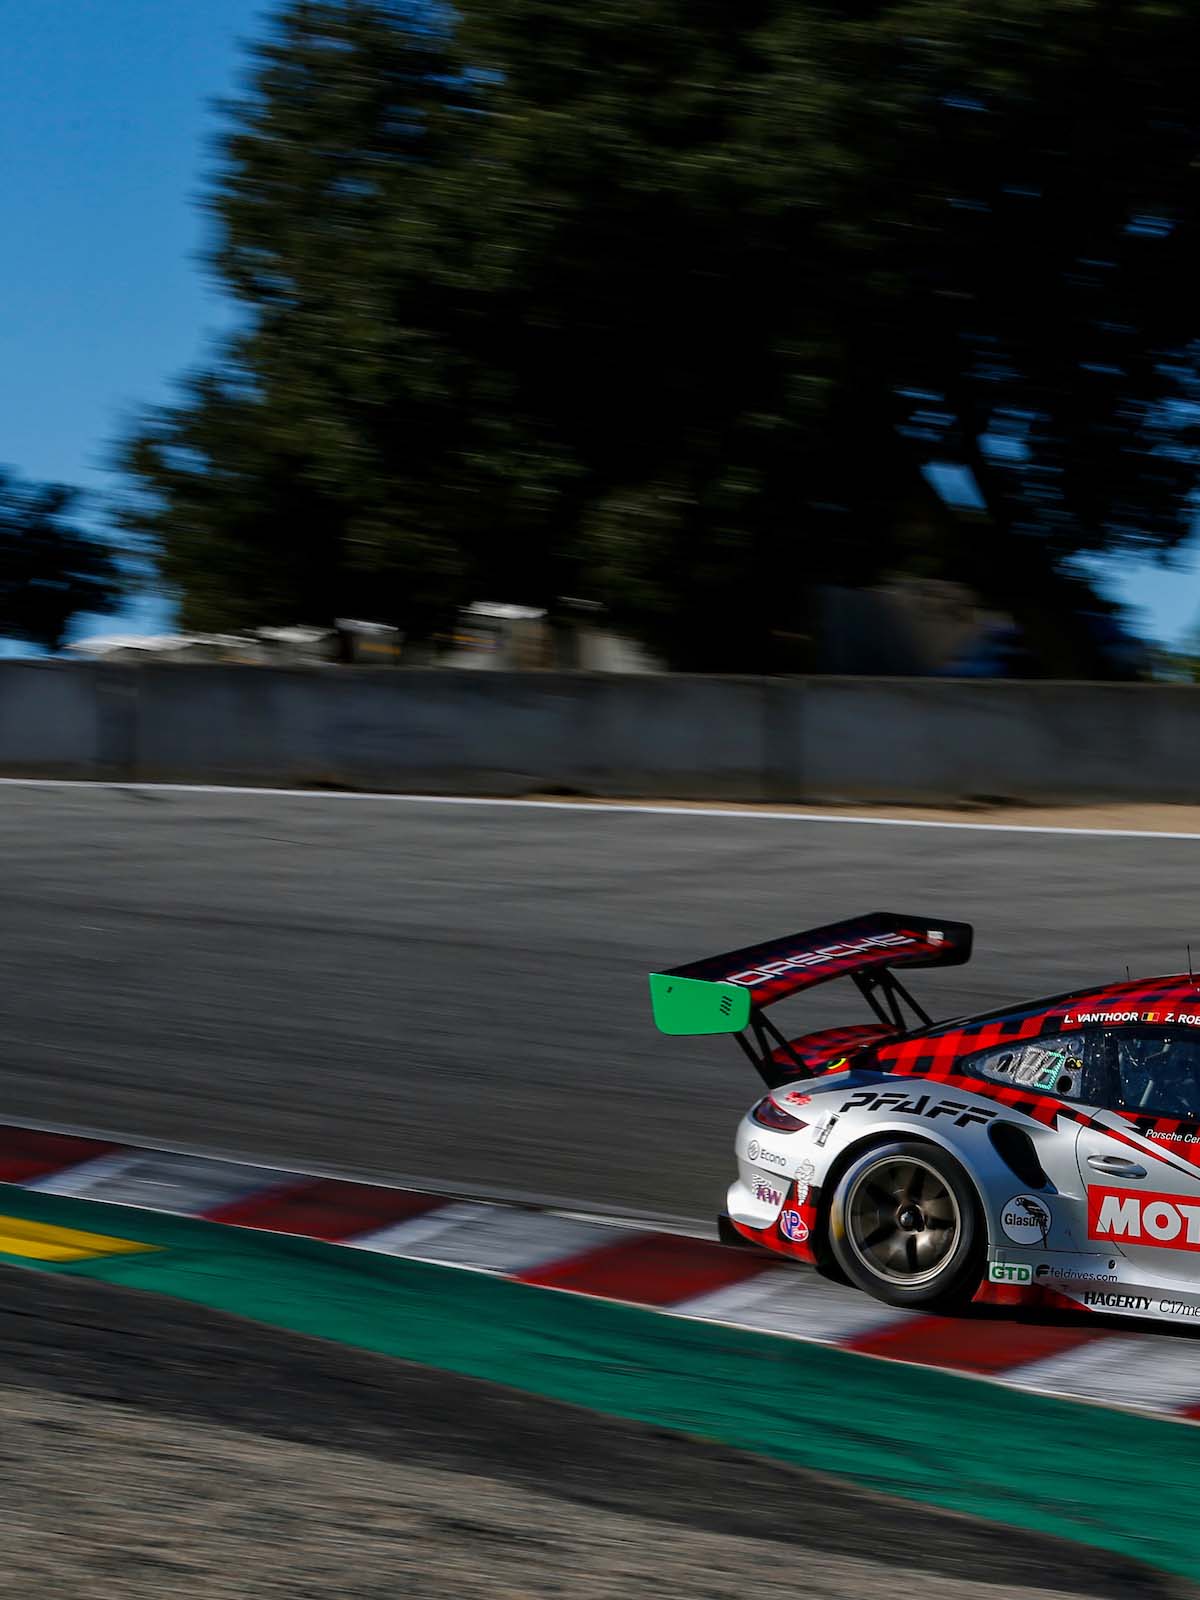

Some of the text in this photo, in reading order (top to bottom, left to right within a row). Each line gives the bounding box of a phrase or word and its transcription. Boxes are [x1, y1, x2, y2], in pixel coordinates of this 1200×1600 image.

[716, 932, 916, 987] ORSCHE
[1064, 1012, 1139, 1024] L. VANTHOOR
[1164, 1013, 1175, 1022] Z.
[839, 1092, 999, 1128] PFAFF
[1145, 1128, 1182, 1142] Porsche
[760, 1149, 786, 1167] Econo
[991, 1265, 1030, 1281] GTD
[1084, 1291, 1152, 1311] HAGERTY
